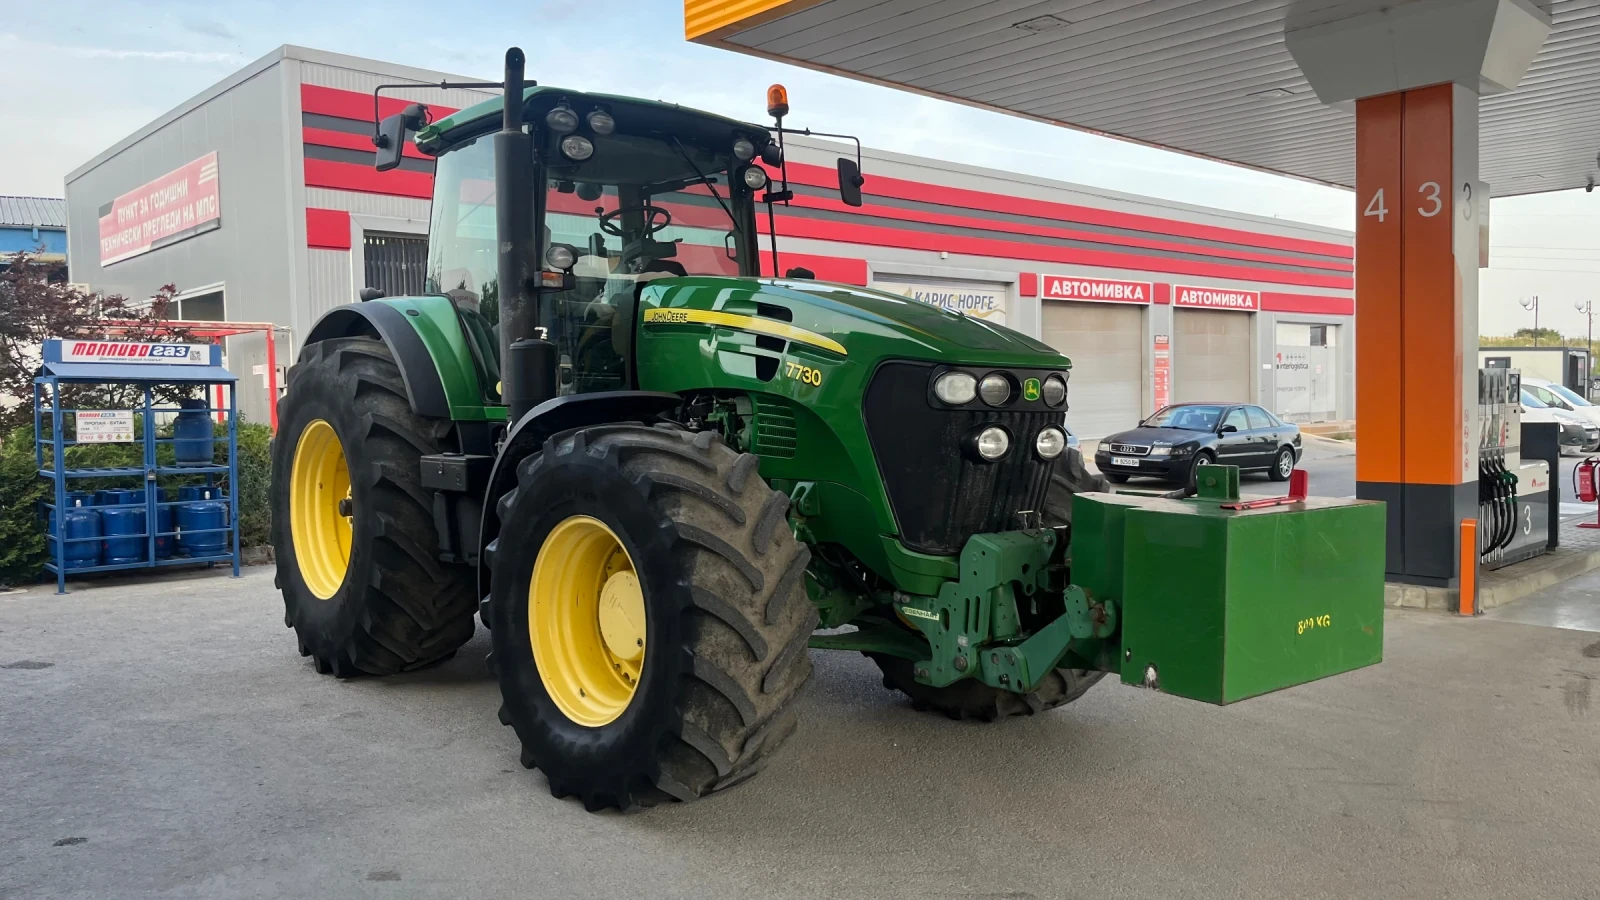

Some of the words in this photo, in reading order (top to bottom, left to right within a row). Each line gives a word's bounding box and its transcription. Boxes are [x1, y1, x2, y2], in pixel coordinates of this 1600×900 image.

[117, 201, 139, 224] ПУНКТ
[140, 198, 149, 215] ЗА
[150, 178, 188, 209] ГОДИШНИ
[1363, 188, 1389, 223] 4
[1417, 181, 1443, 217] 3
[1462, 182, 1472, 222] 3
[101, 224, 141, 253] ТЕХНИЧЕСКИ
[143, 209, 181, 238] ПРЕГЛЕДИ
[183, 204, 195, 224] НА
[196, 194, 216, 218] МПС
[957, 294, 995, 311] НОРГЕ
[1050, 279, 1144, 300] АВТОМИВКА
[1180, 289, 1253, 308] АВТОМИВКА
[650, 312, 667, 323] JOHN
[667, 310, 688, 322] DEERE
[786, 361, 822, 387] 7730
[1523, 504, 1532, 535] 3
[1316, 614, 1331, 628] KG
